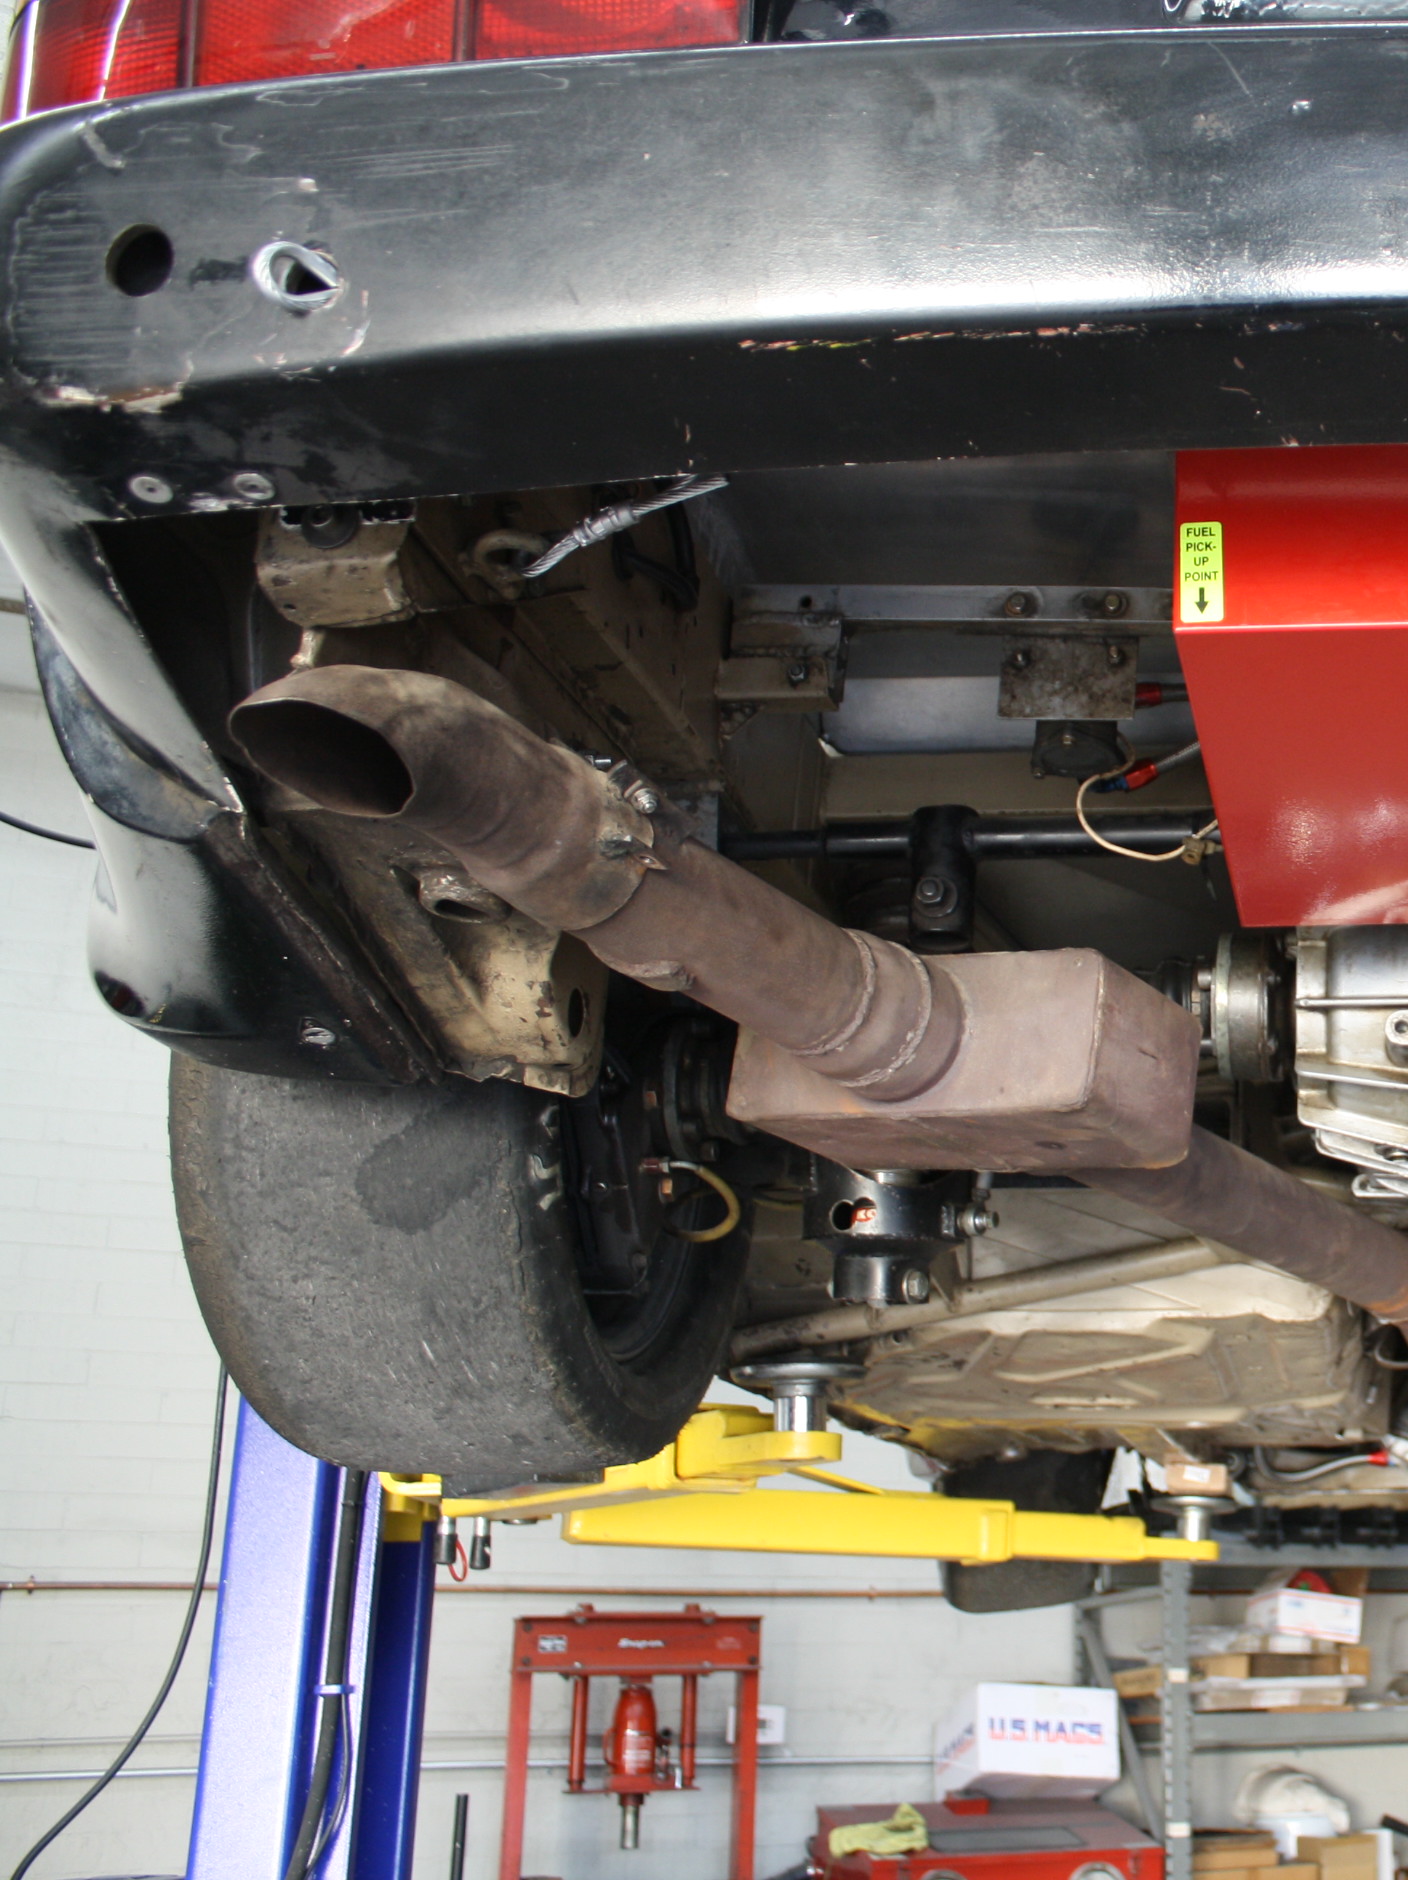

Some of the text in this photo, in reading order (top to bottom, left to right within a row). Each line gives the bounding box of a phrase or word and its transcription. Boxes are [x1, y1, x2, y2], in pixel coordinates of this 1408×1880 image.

[1186, 527, 1216, 537] FUEL
[1186, 541, 1217, 552] PICK-
[1193, 556, 1209, 567] UP
[1184, 571, 1219, 582] POINT
